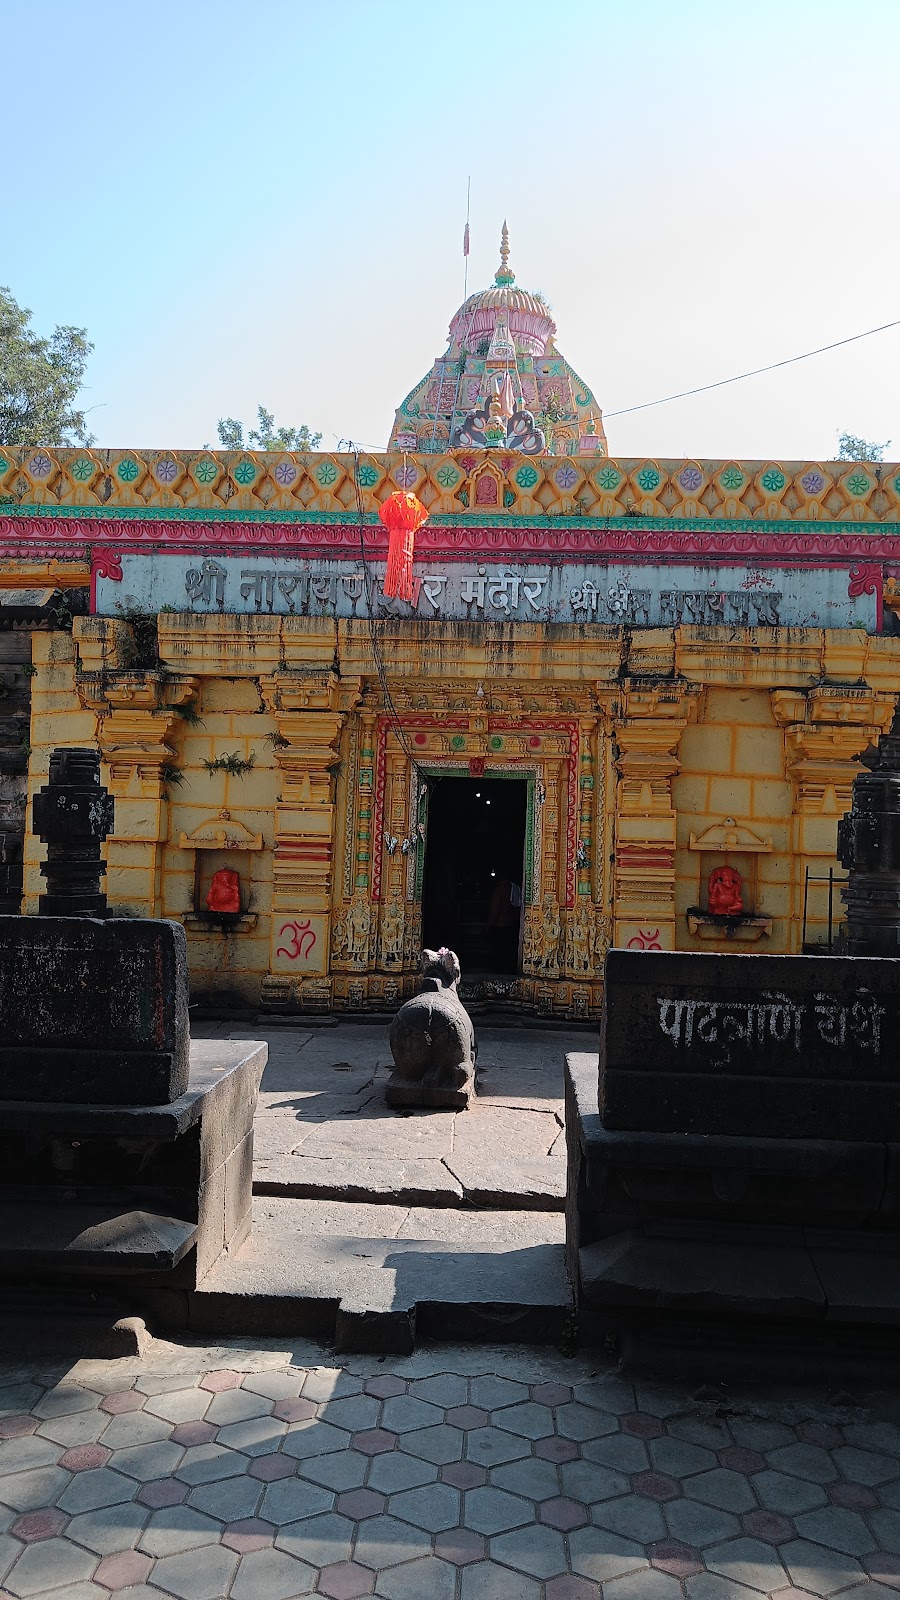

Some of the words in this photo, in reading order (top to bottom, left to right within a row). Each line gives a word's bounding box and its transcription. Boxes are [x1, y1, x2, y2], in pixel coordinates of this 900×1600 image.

[185, 559, 227, 603] श्री
[460, 566, 547, 615] मंदीर
[569, 580, 600, 611] श्री
